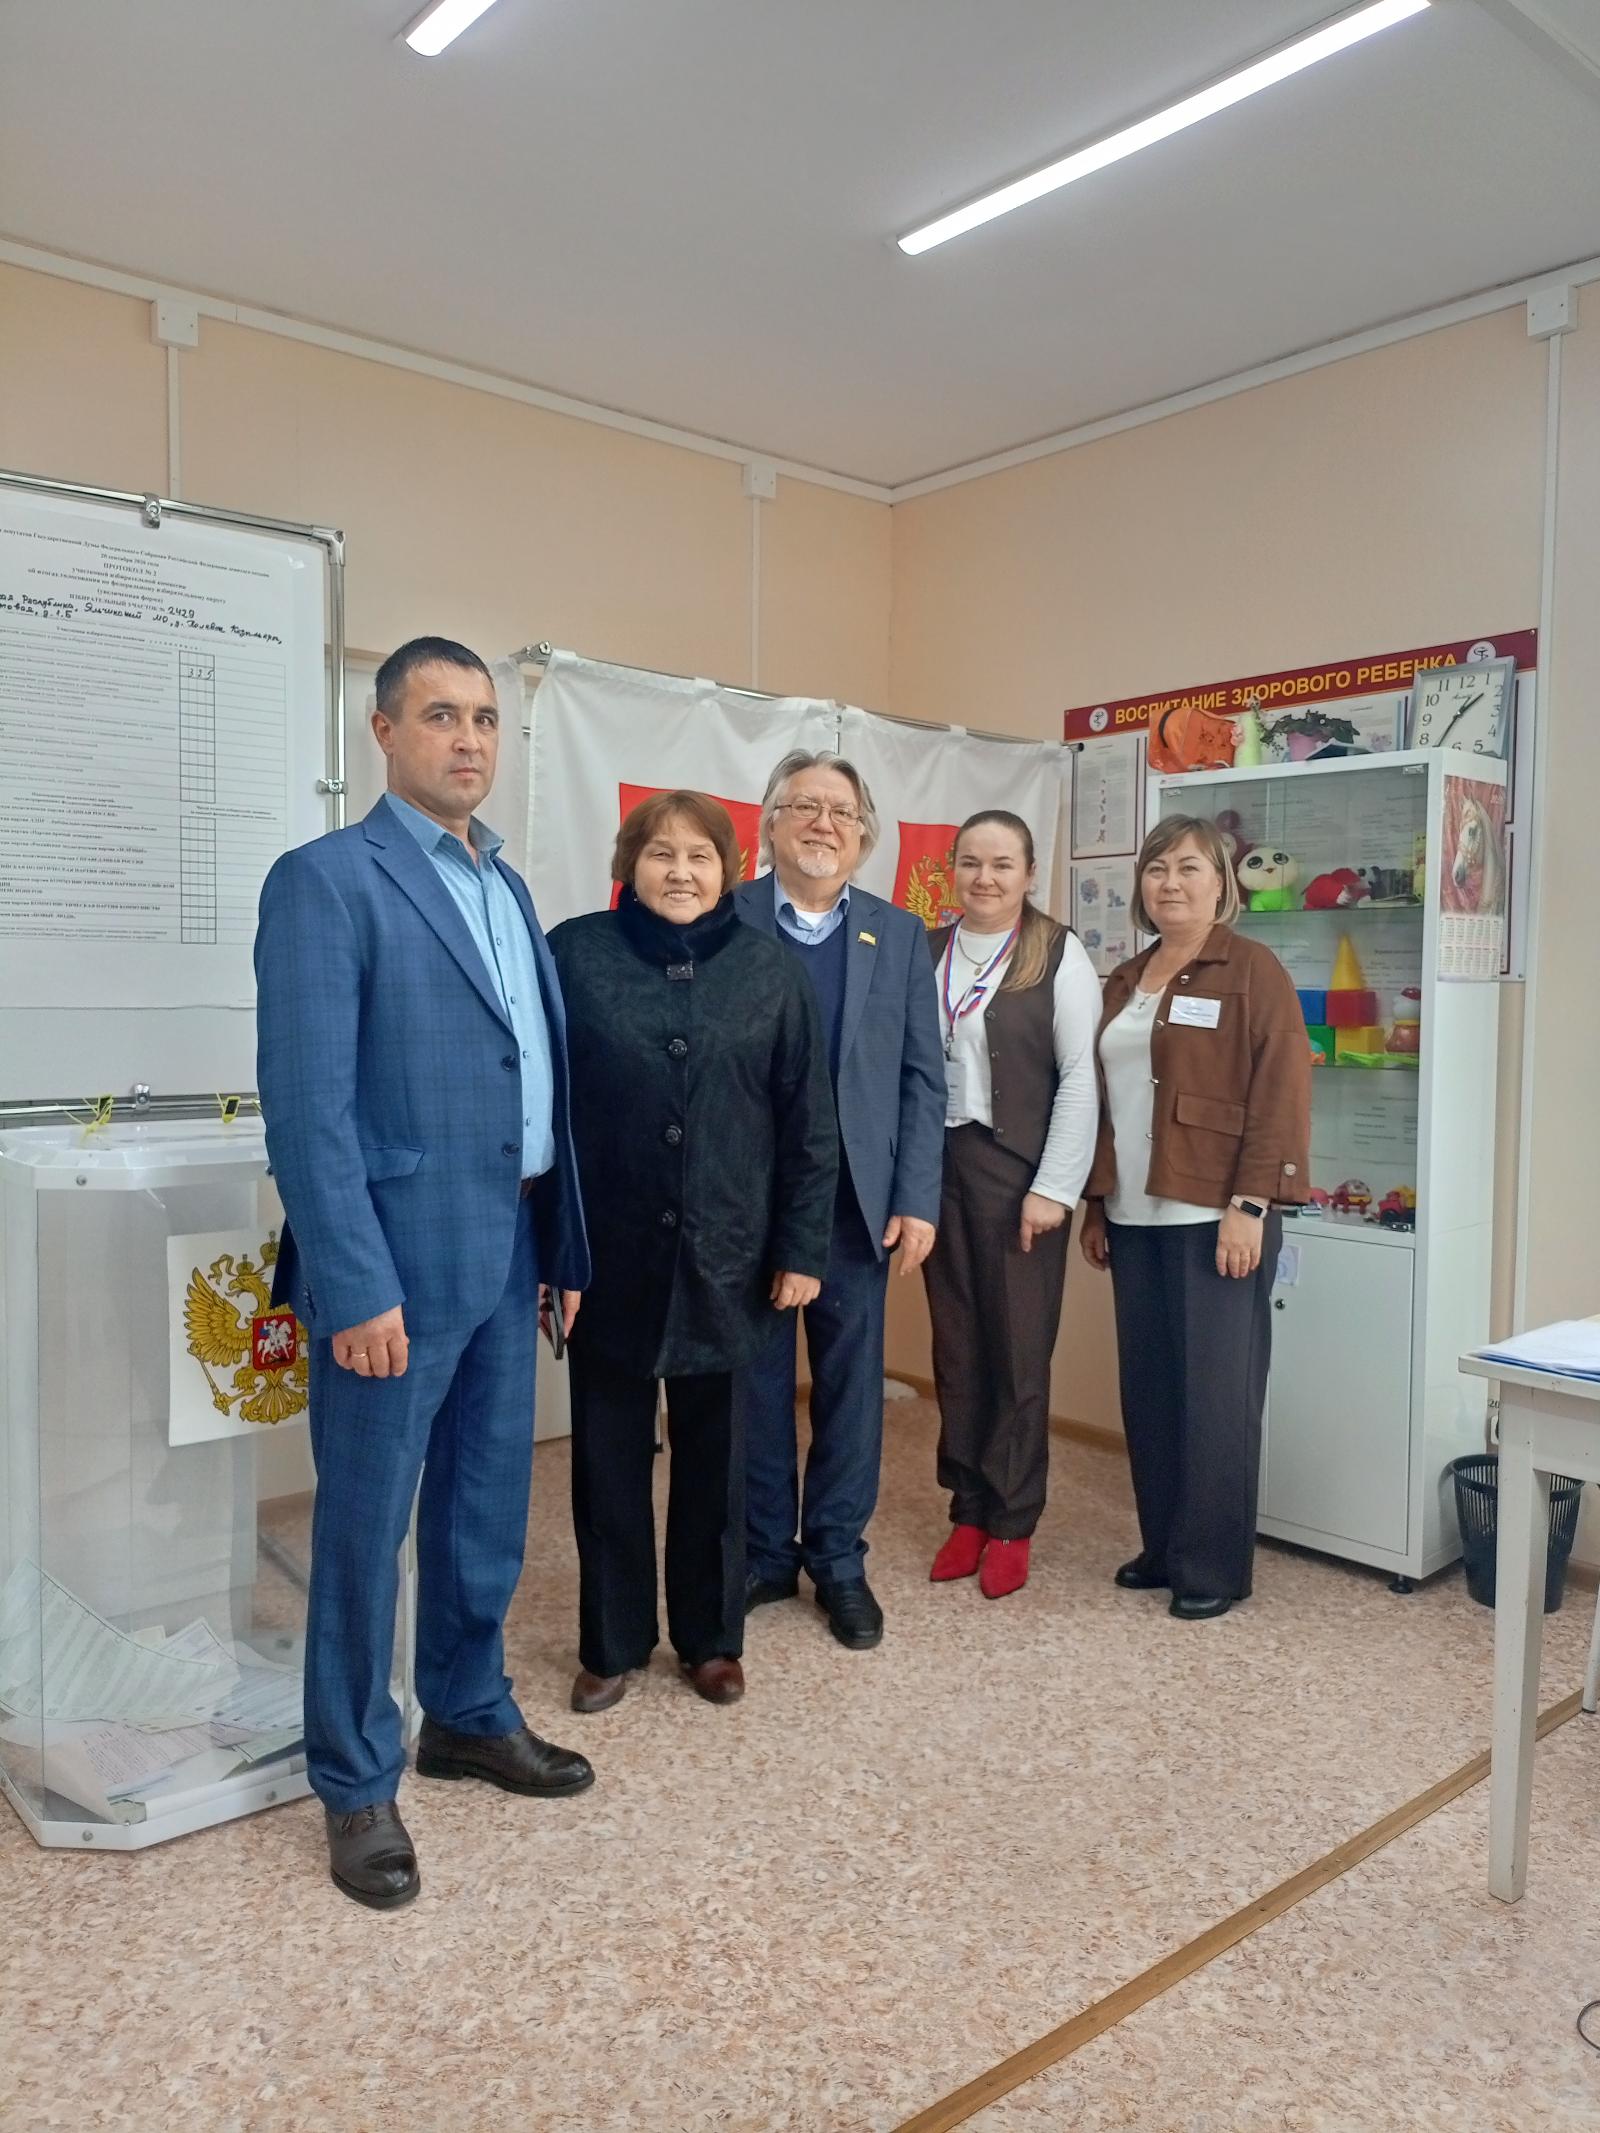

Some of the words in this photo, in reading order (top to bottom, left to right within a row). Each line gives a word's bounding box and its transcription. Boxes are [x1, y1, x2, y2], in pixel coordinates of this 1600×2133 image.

[1438, 679, 1450, 693] 11
[1459, 675, 1476, 689] 12
[1485, 673, 1490, 685] 1
[1114, 690, 1227, 725] ВОСПИТАНИЕ
[1231, 670, 1351, 708] ЗДОРОВОГО
[1356, 652, 1457, 686] РЕБЕНКА
[1494, 684, 1504, 698] 2
[1425, 693, 1440, 708] 10
[1491, 704, 1500, 718] 3
[1422, 713, 1433, 727] 9
[1488, 726, 1496, 737] 4
[1419, 733, 1429, 745] 8
[1473, 739, 1484, 752] 5
